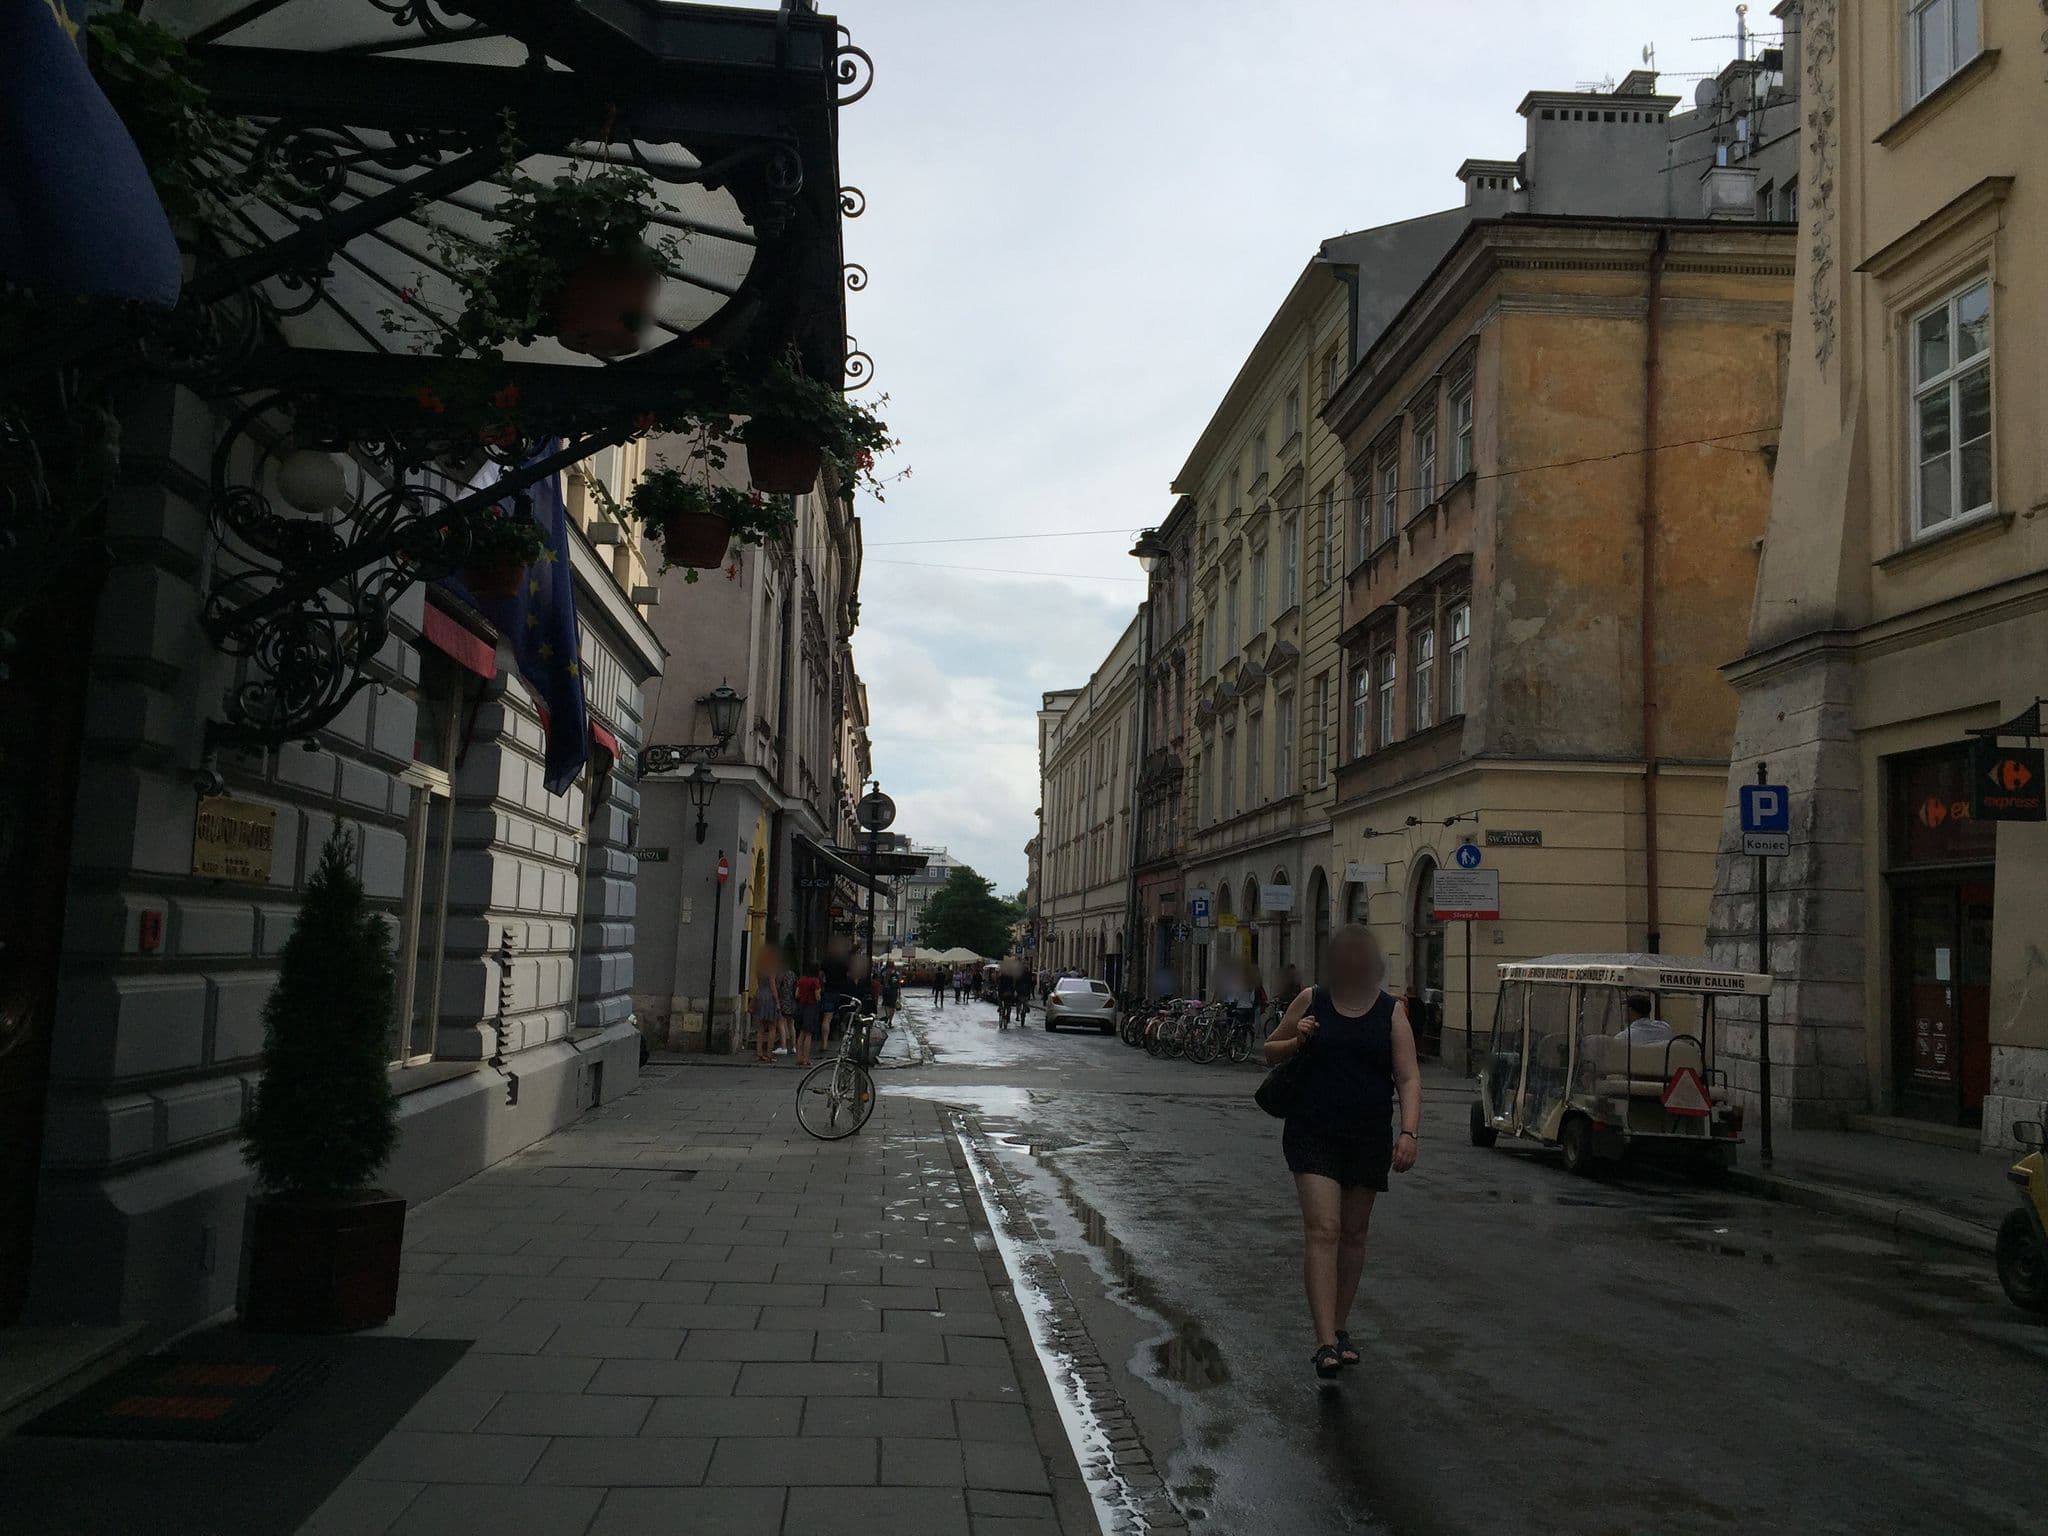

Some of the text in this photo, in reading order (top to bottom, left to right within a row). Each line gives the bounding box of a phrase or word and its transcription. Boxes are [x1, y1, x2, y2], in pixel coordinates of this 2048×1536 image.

[1752, 791, 1778, 826] P
[1984, 797, 2039, 810] express
[1747, 839, 1784, 849] Koniec
[1473, 911, 1480, 919] A
[1545, 968, 1568, 979] QUARTER
[1660, 973, 1744, 988] KRAKÓW CALLING
